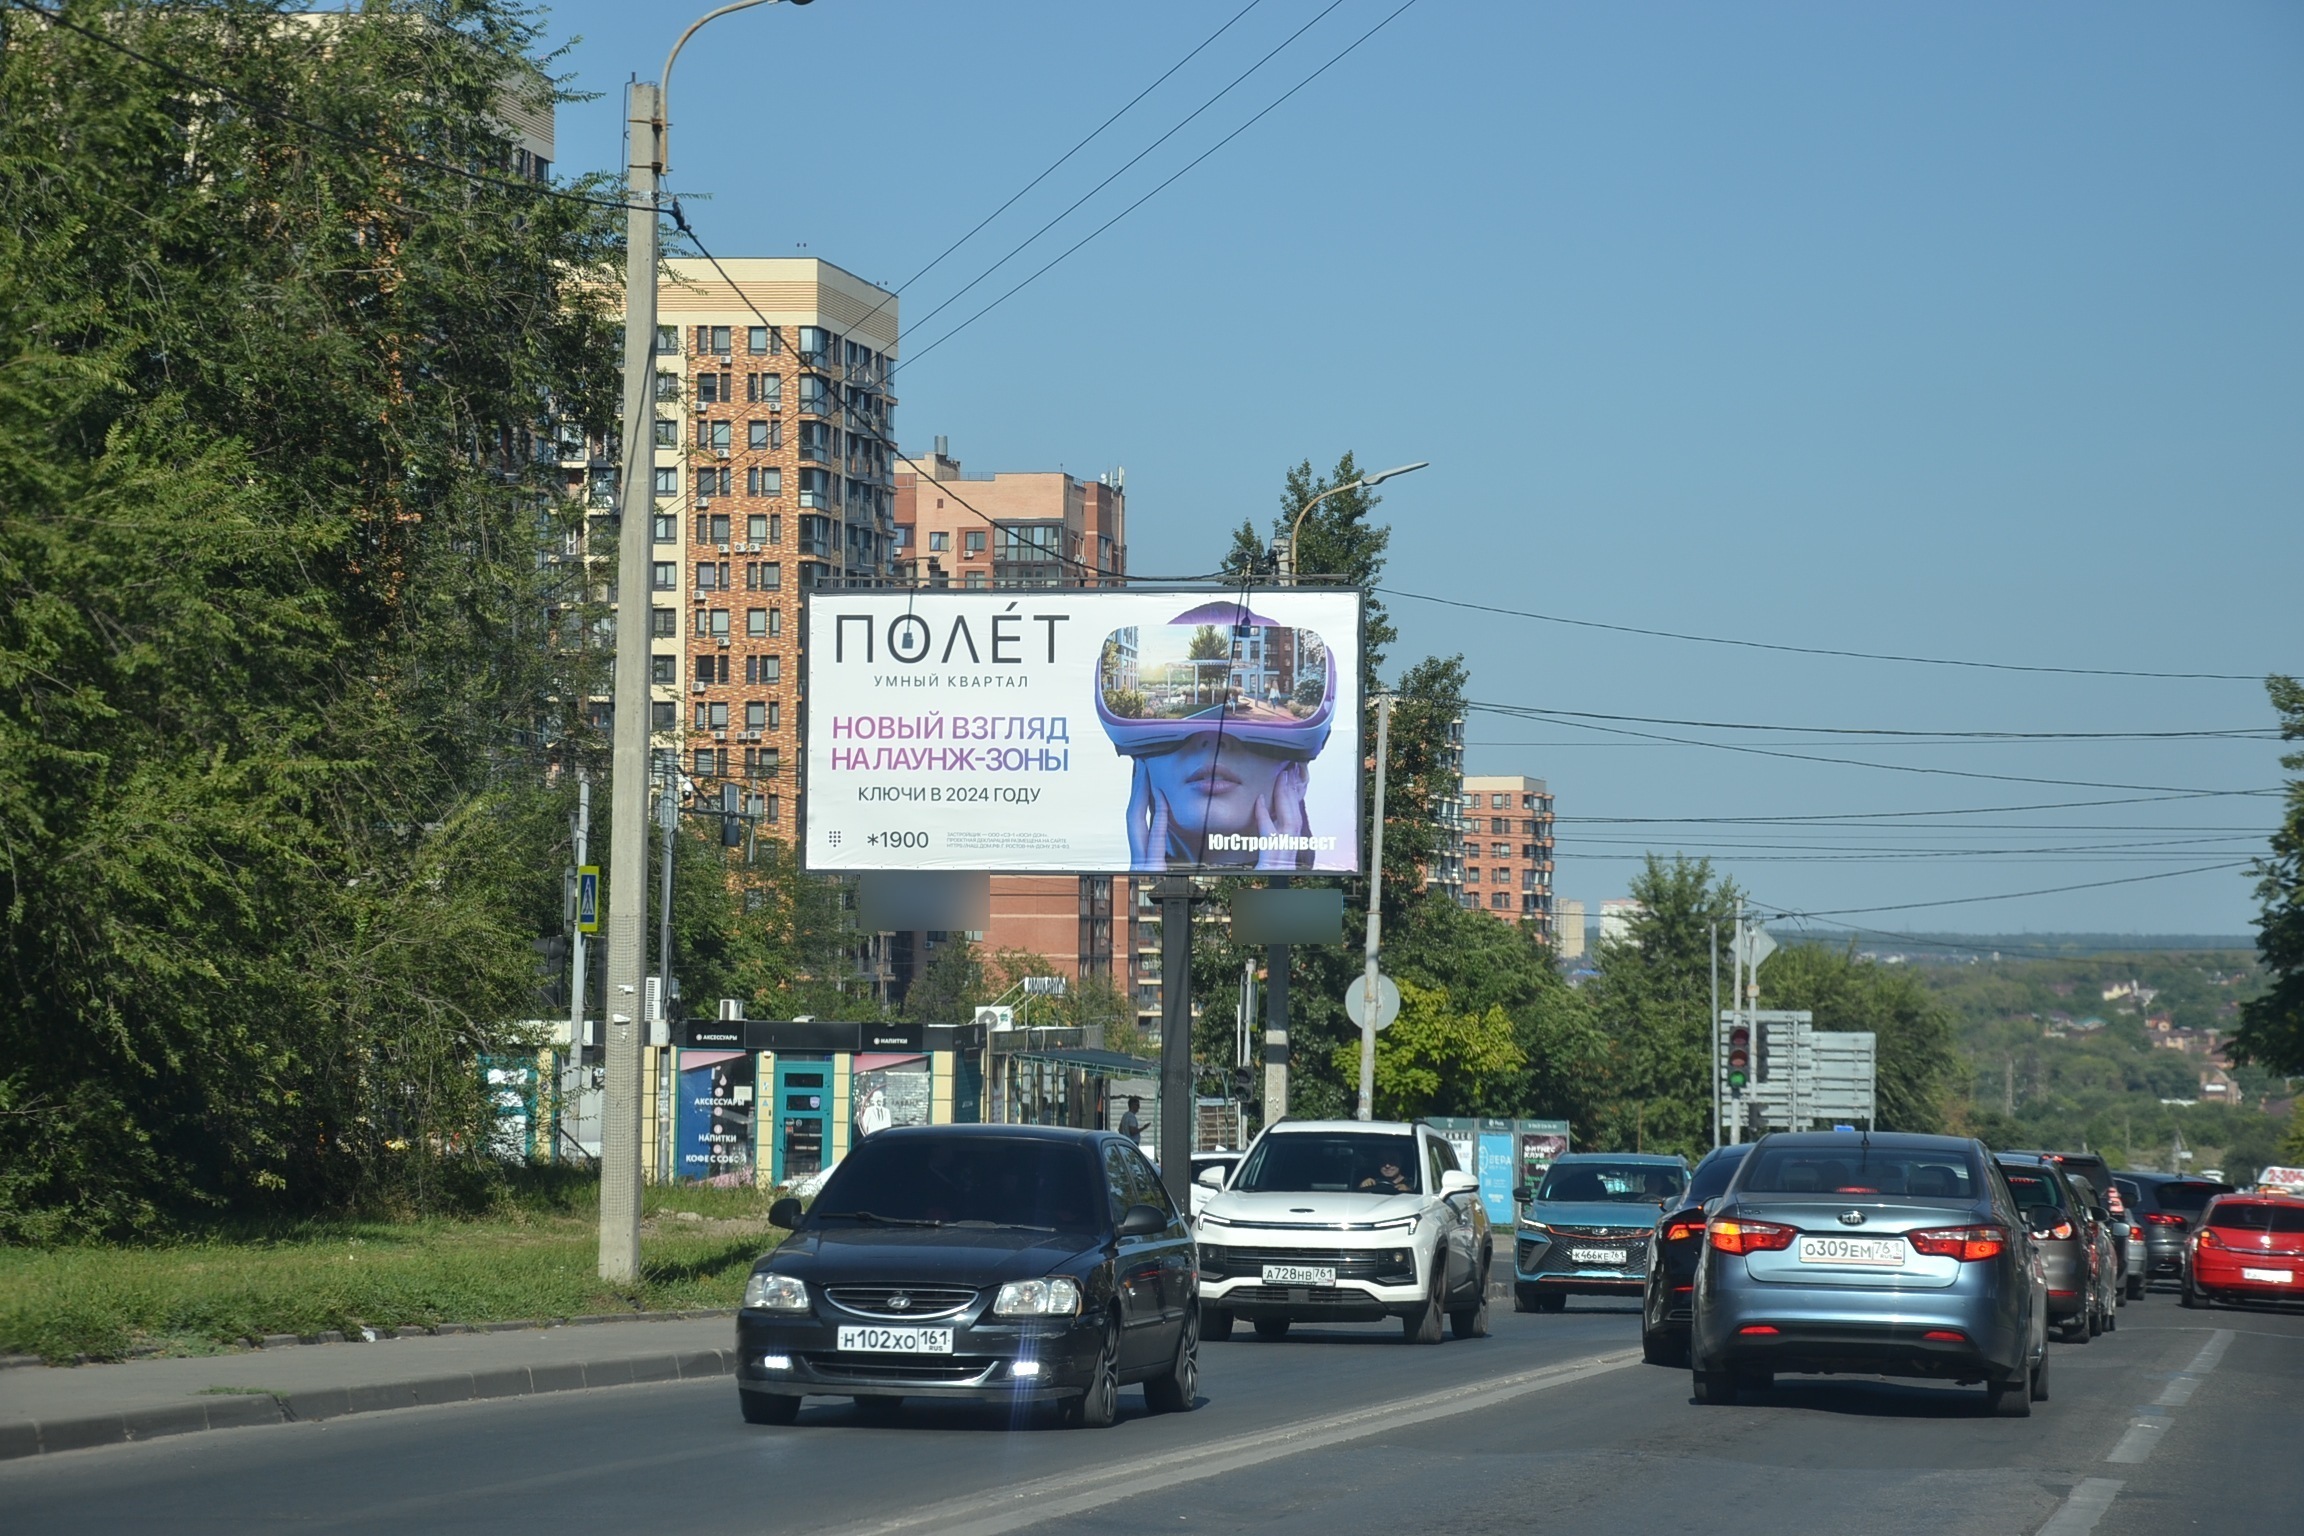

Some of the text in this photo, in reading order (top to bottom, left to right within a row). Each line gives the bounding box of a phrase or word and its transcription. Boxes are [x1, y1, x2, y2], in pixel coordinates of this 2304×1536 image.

[873, 673, 1029, 688] УМНЫЙ КВАРТАЛ
[832, 710, 1070, 745] НОВЫЙ ВЗГЛЯД
[831, 747, 1069, 772] НА ЛАУНЖ-ЗОНЫ
[858, 786, 1041, 805] КЛЮЧИ В 2024 ГОДУ
[1208, 833, 1337, 852] ЮгСтройИнвест
[694, 1097, 745, 1106] АКСЕССУАРЫ
[698, 1133, 737, 1143] НАПИТКИ
[686, 1154, 709, 1163] КОФЕ
[710, 1154, 716, 1163] С
[1841, 1212, 1863, 1223] KIA
[1804, 1240, 1872, 1258] О309ЕМ
[1266, 1267, 1333, 1281] А728НВ 761
[844, 1329, 948, 1350] Н102ХО 161
